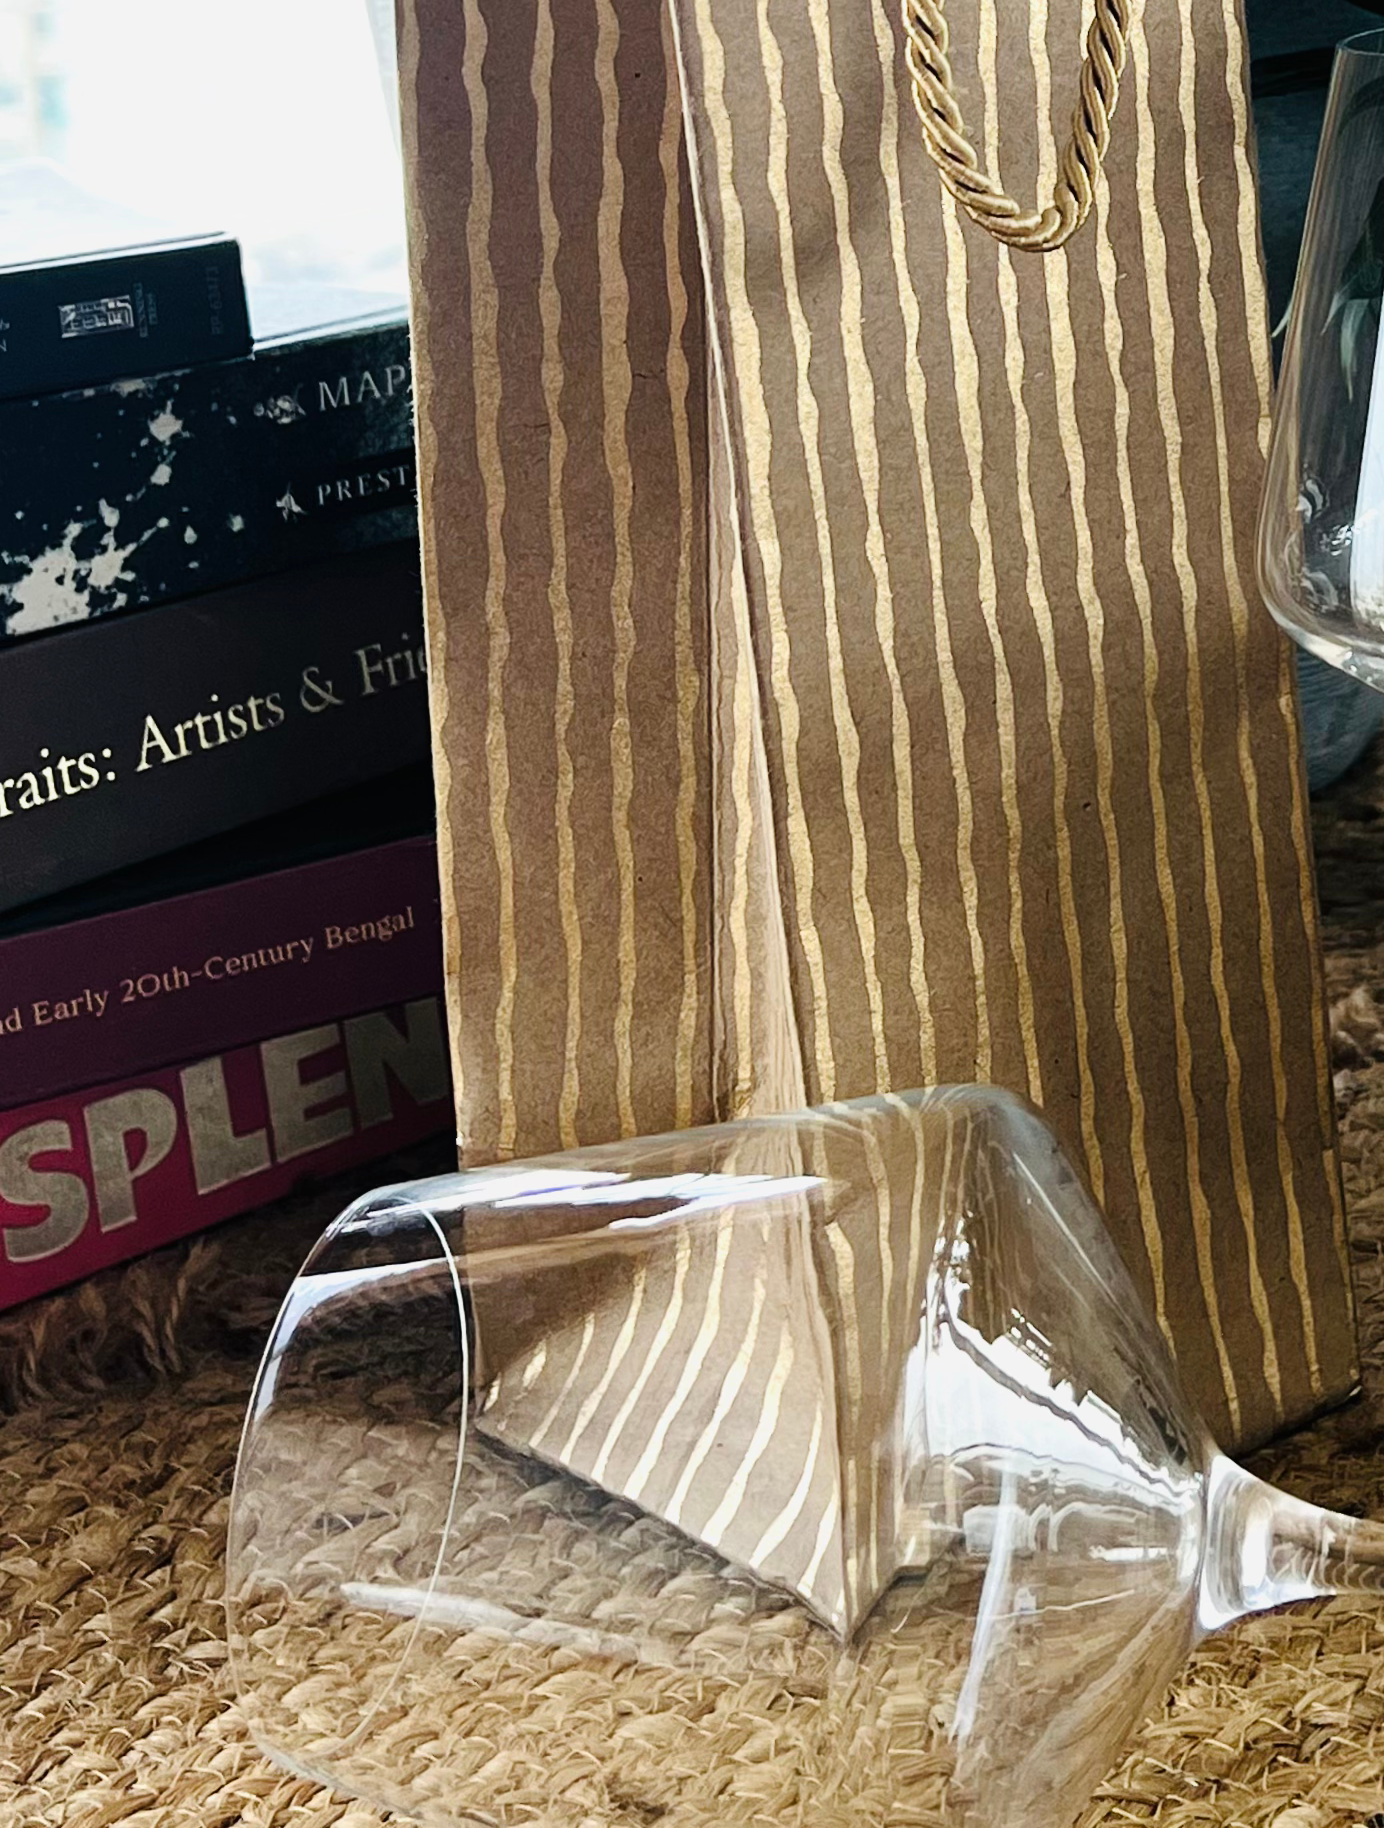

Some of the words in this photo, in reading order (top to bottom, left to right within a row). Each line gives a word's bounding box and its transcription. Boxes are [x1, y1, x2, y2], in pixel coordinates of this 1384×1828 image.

[317, 362, 409, 412] MAP
[315, 464, 411, 507] PREST
[0, 747, 117, 819] raits:
[135, 693, 286, 772] Artists
[299, 665, 345, 713] &
[0, 1006, 23, 1036] d
[31, 988, 110, 1026] Early
[119, 935, 315, 1004] 20th-Century
[325, 906, 416, 951] Bengal
[0, 996, 451, 1264] SPLEN
